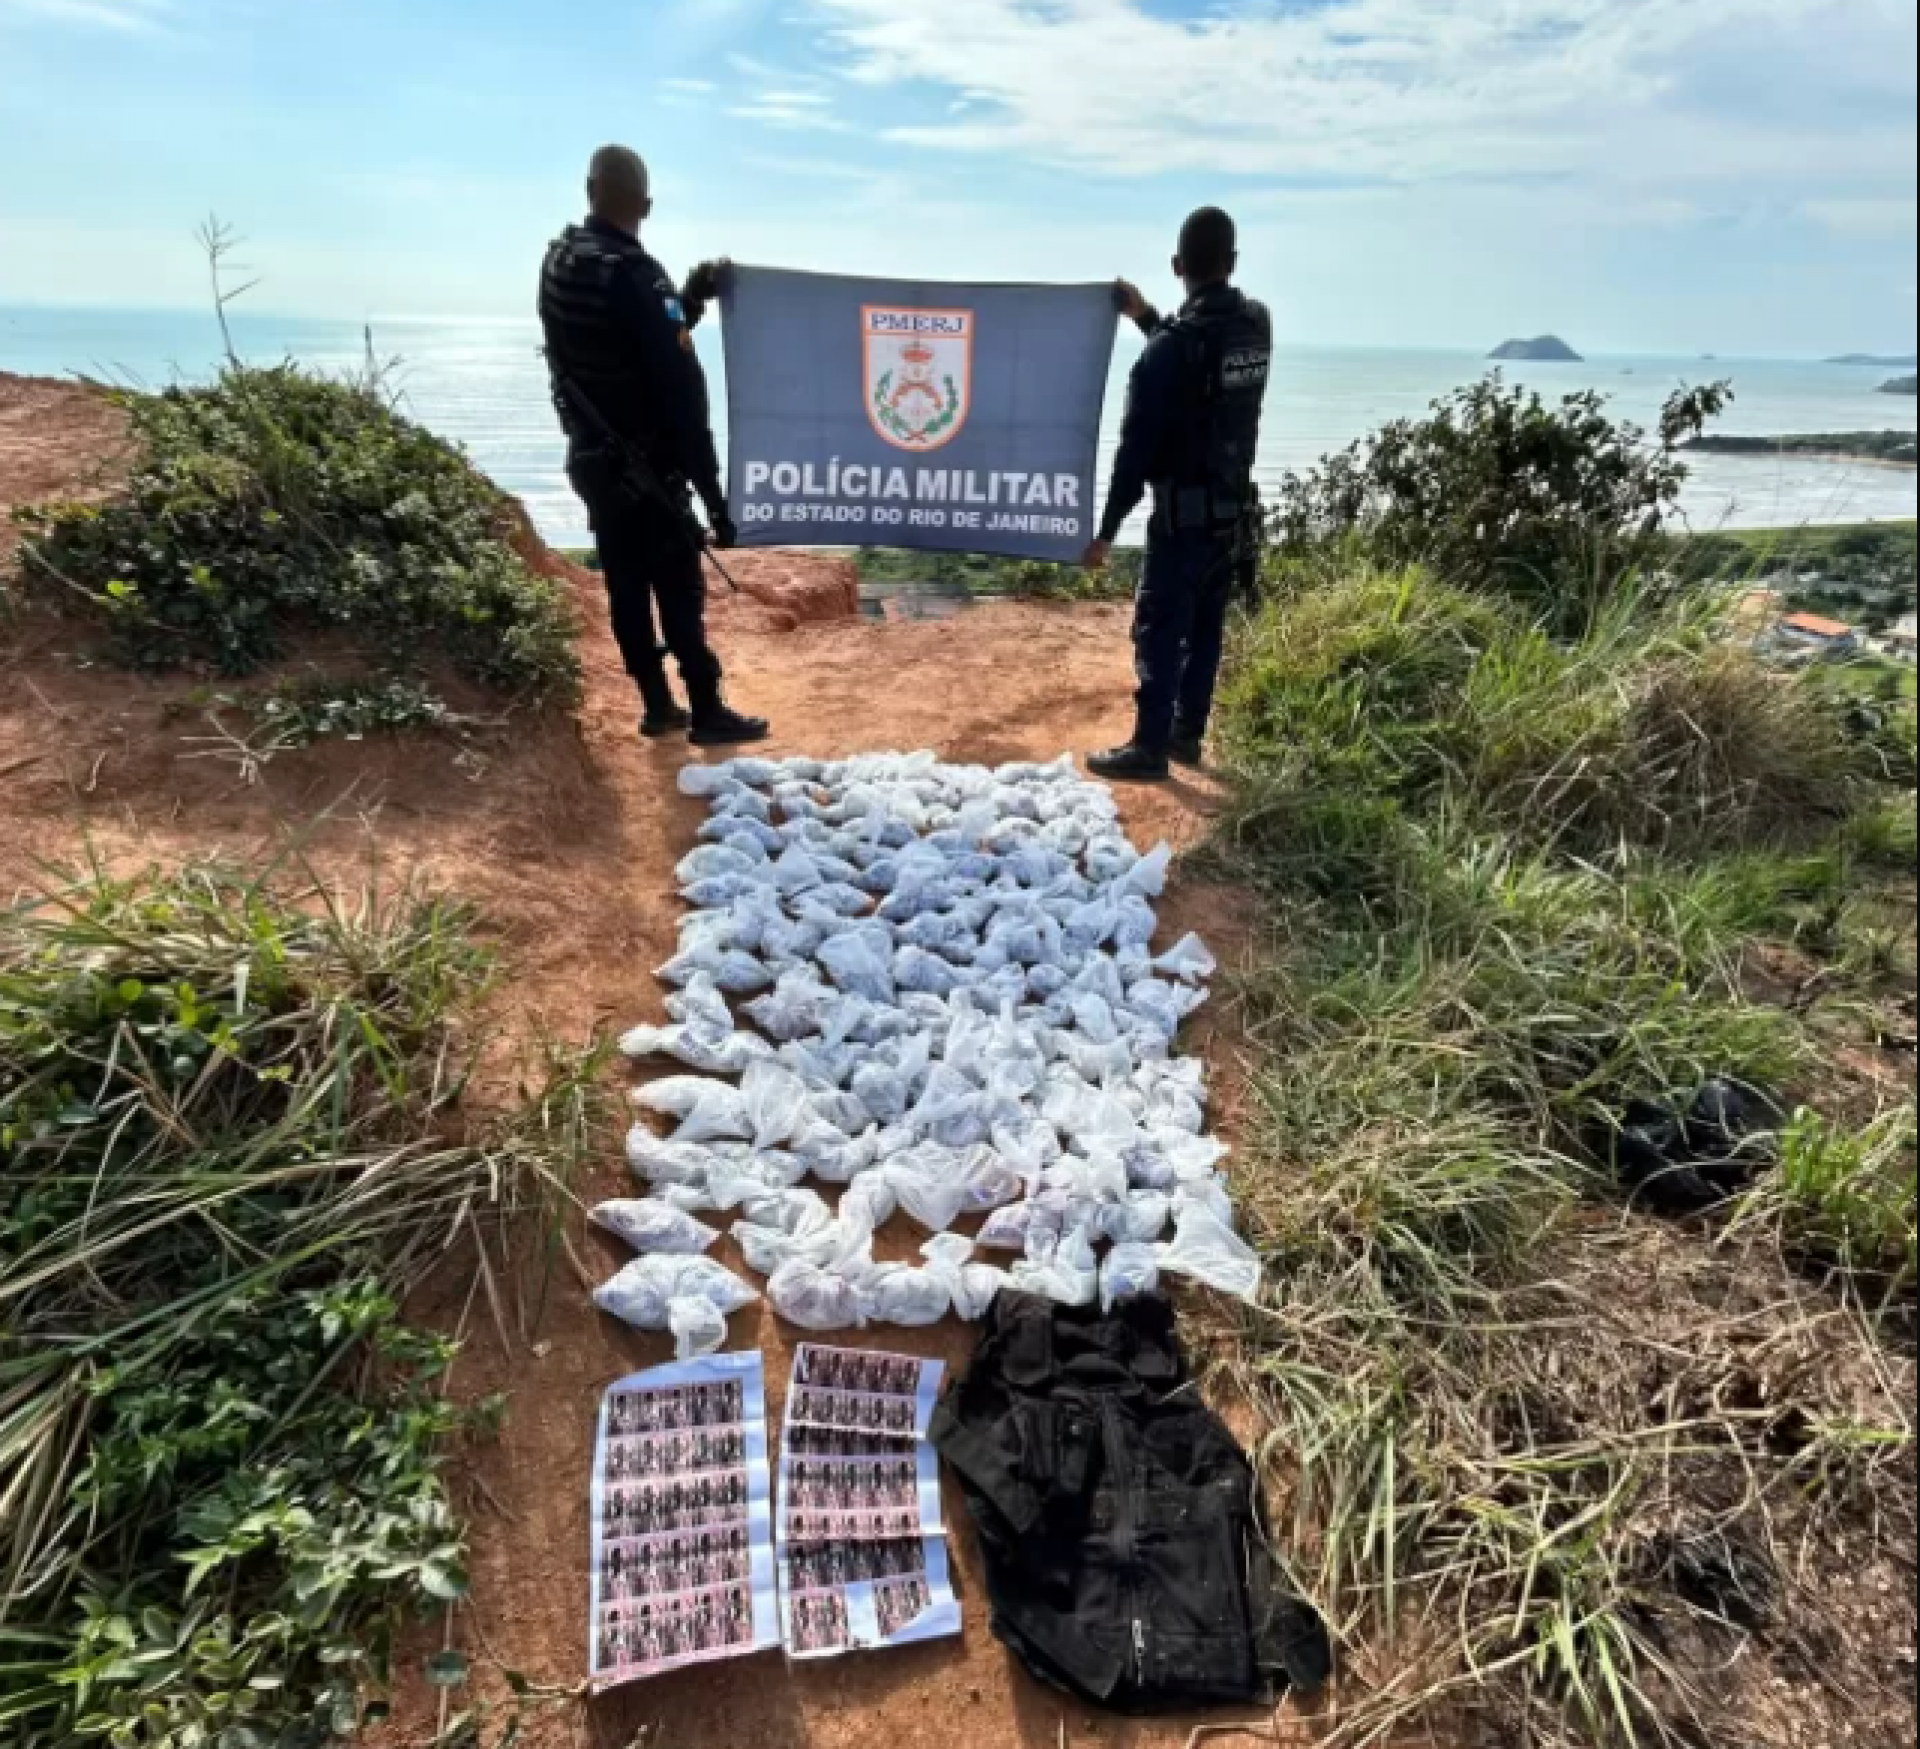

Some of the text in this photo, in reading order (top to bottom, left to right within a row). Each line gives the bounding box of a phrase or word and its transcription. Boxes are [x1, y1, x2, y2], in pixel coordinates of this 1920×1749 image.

[871, 313, 964, 333] PMERJ
[744, 456, 1079, 507] POLÍCIA MILITAR
[742, 503, 1079, 536] DO ESTADO DO RIO DE JANEIRO
